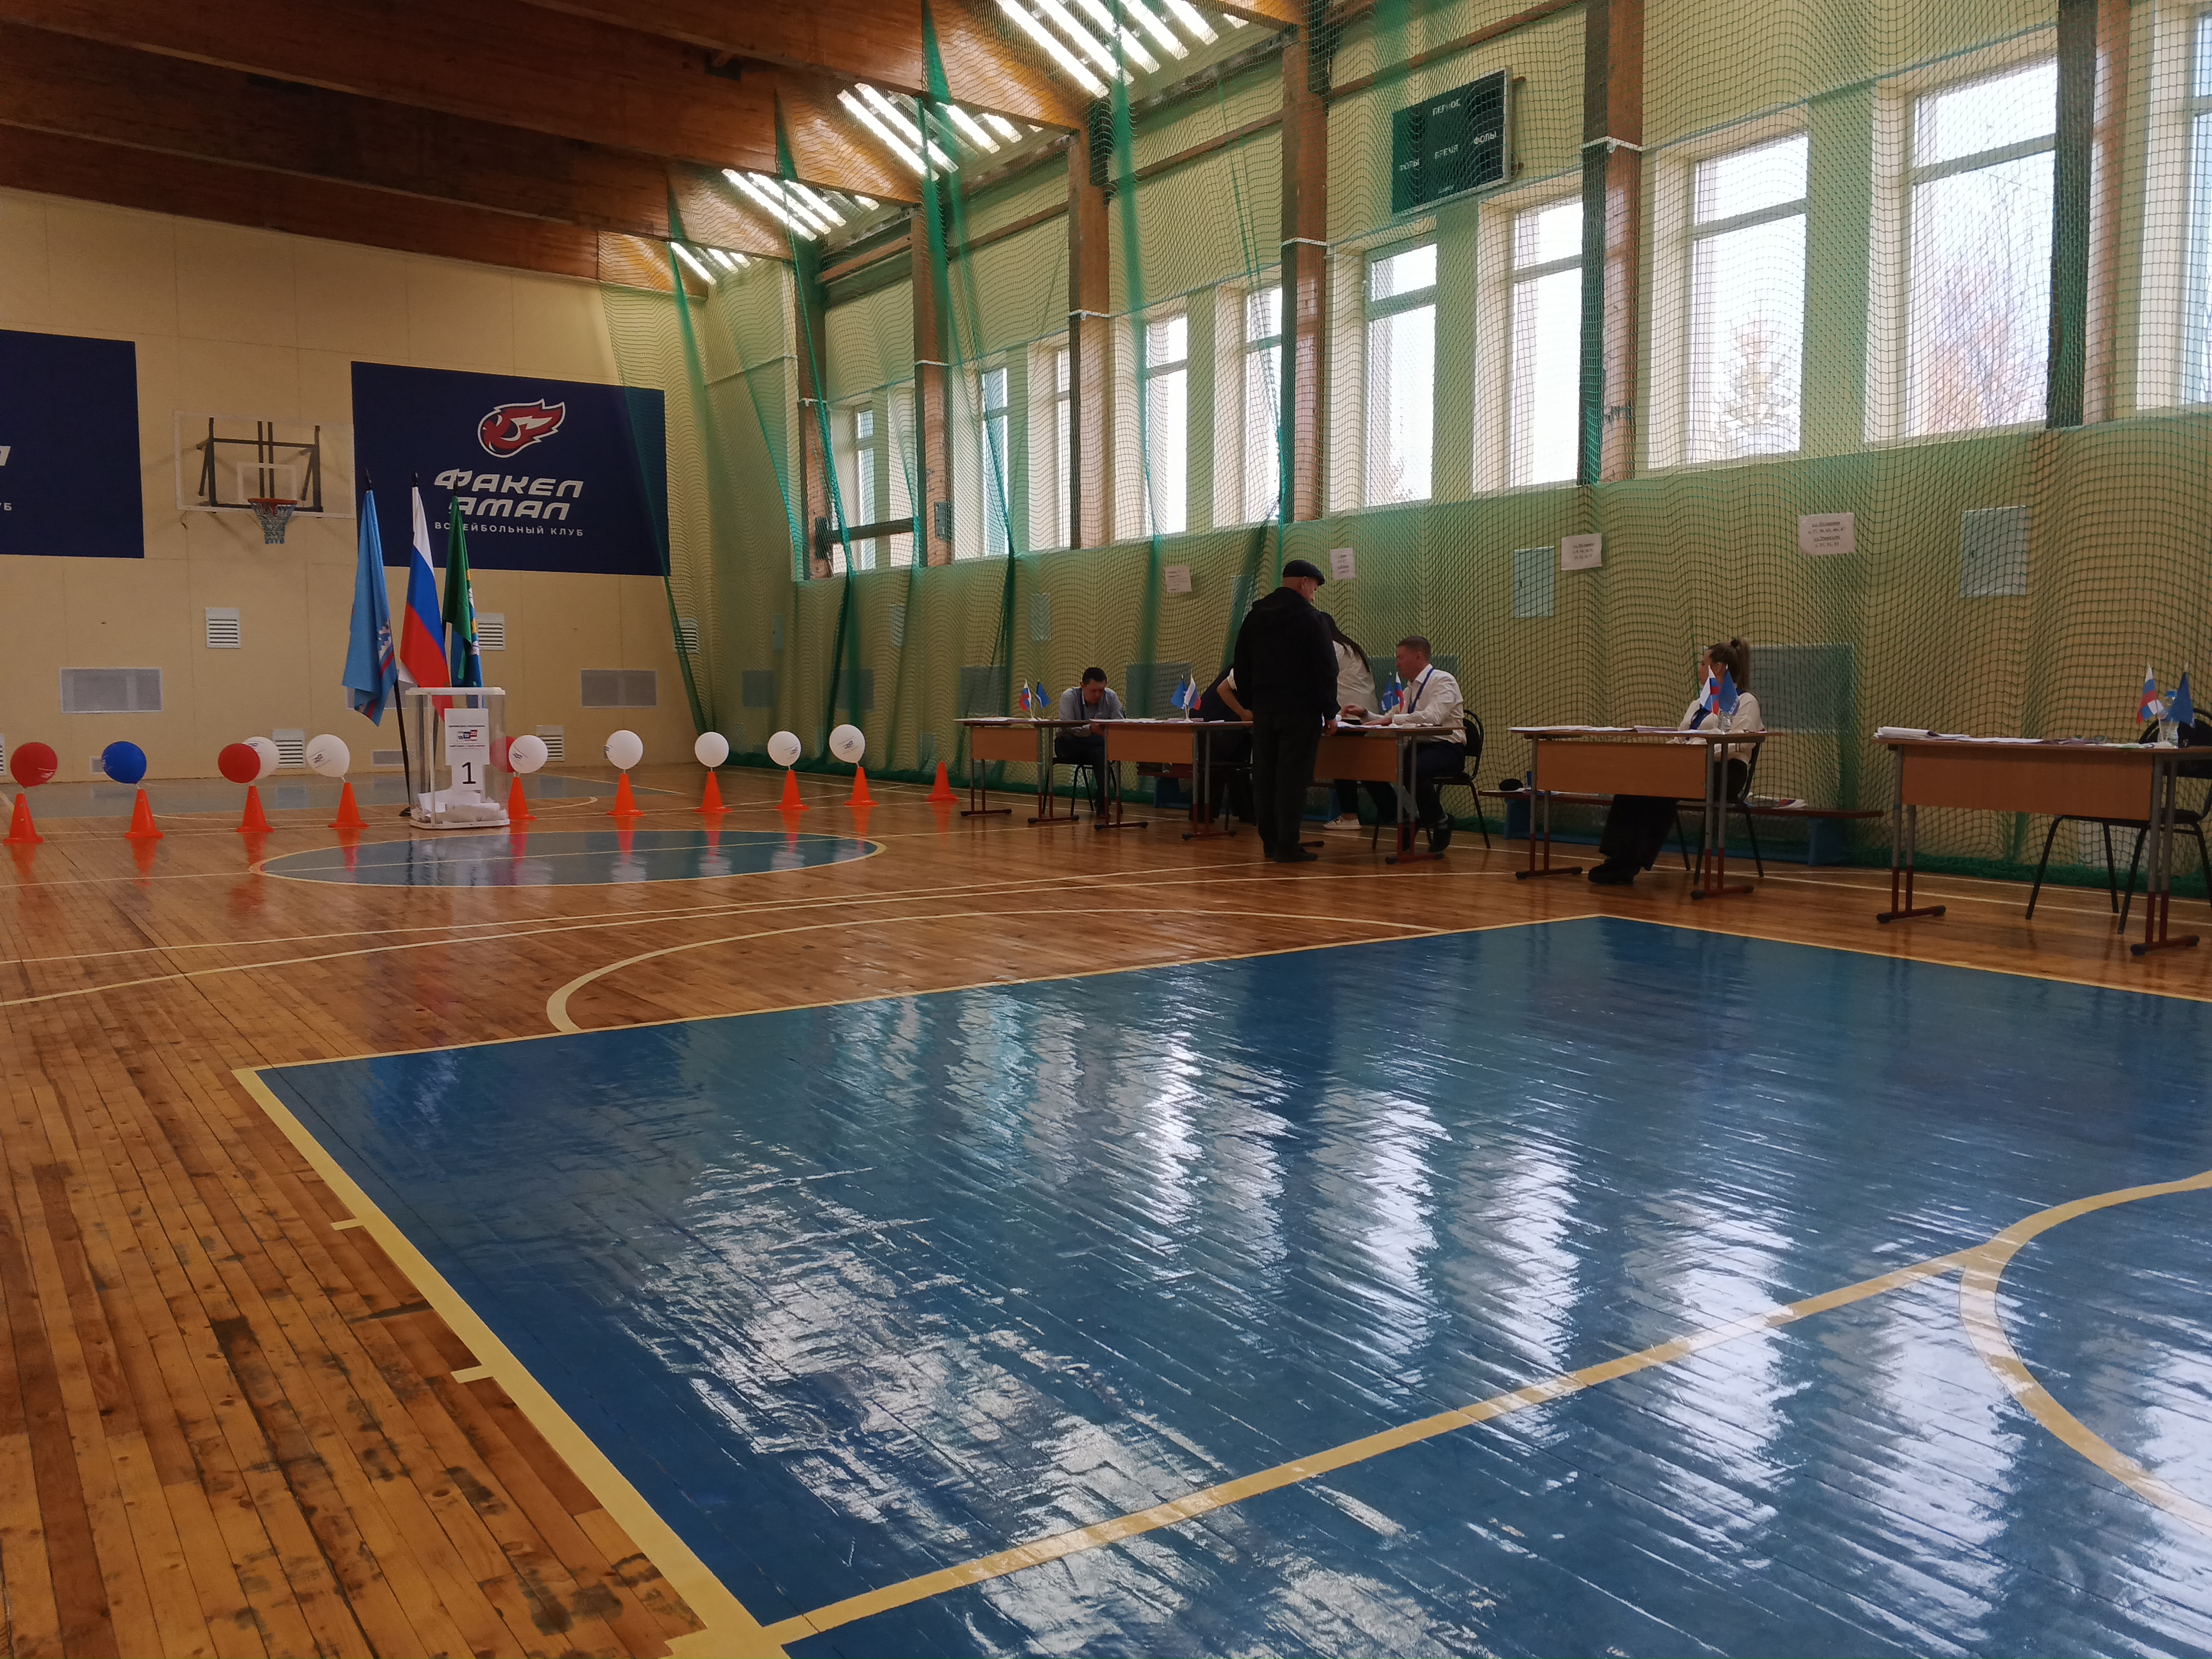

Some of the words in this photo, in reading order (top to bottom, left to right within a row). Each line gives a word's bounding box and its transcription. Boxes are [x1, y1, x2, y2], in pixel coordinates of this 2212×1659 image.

[1473, 130, 1497, 145] ФОЛЫ
[434, 468, 584, 499] ФАКЕЛ
[434, 521, 545, 535] ВОЕЙБОЛЬНЫЙ
[550, 527, 584, 537] КЛУБ
[462, 761, 476, 784] 1
